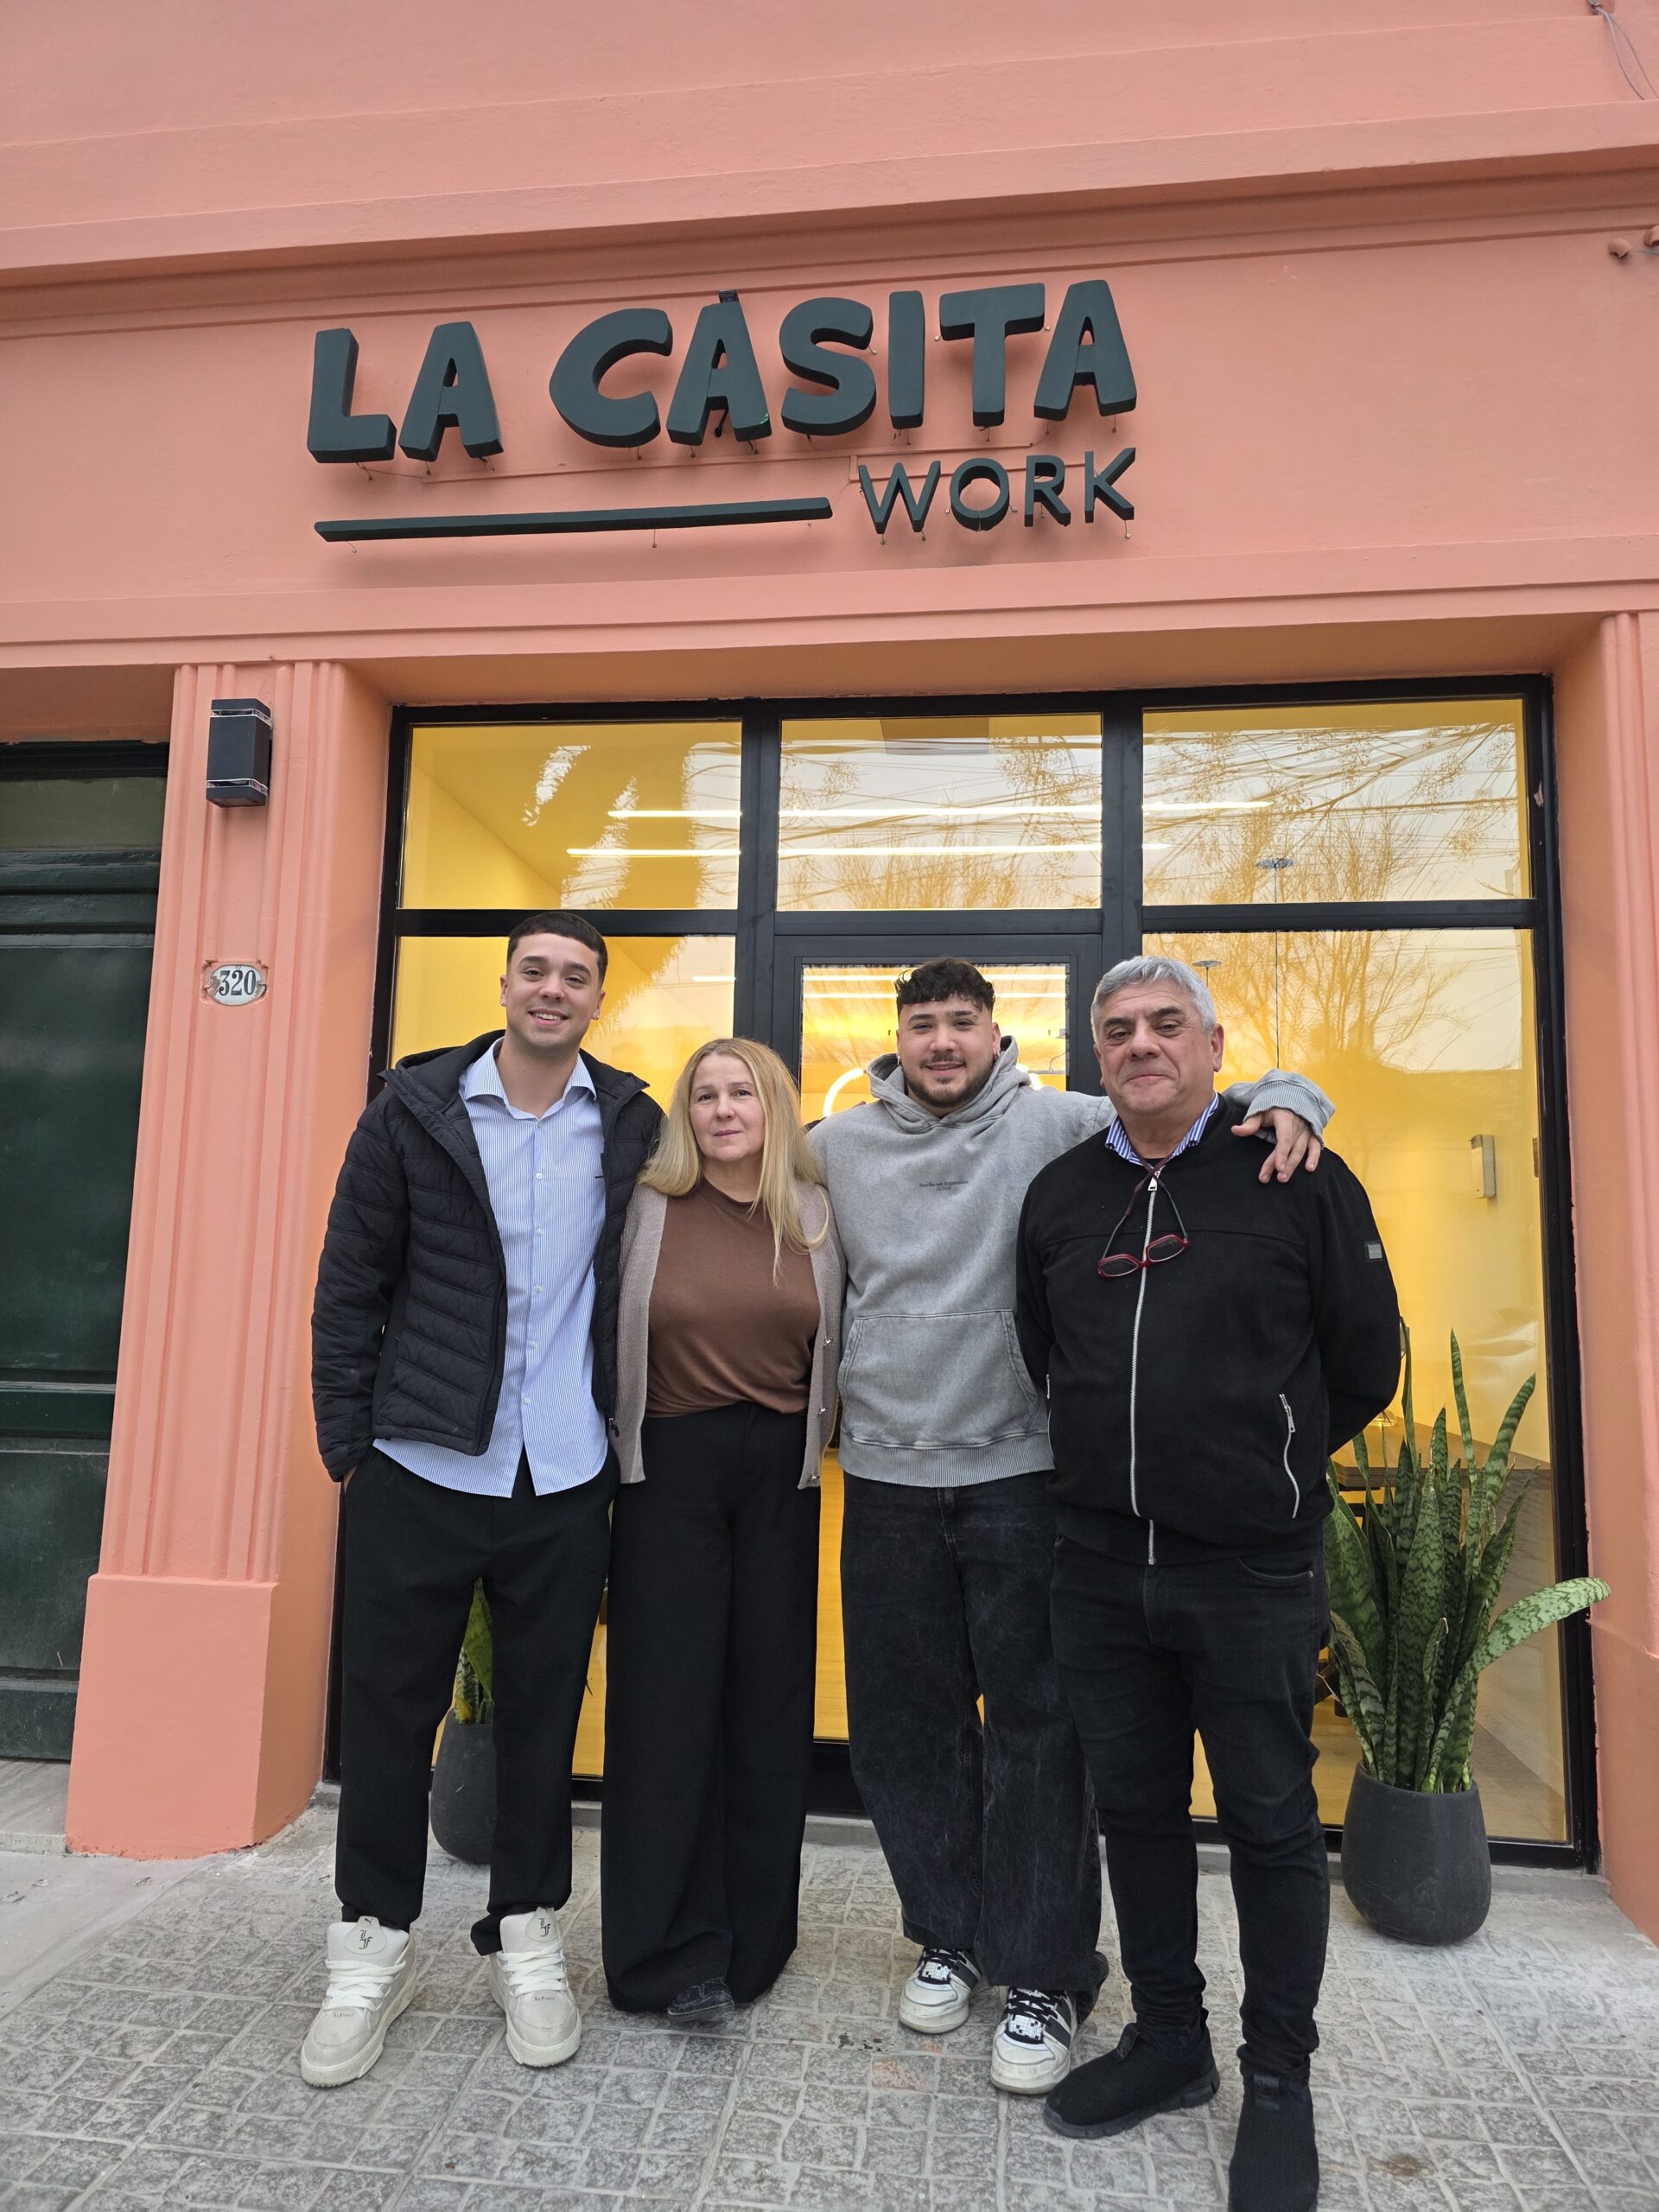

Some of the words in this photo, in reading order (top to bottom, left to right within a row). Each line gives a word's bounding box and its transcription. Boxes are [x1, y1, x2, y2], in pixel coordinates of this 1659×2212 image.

[307, 321, 504, 464] LA
[549, 279, 1137, 448] CASITA
[858, 447, 1136, 534] WORK
[219, 969, 257, 996] 320
